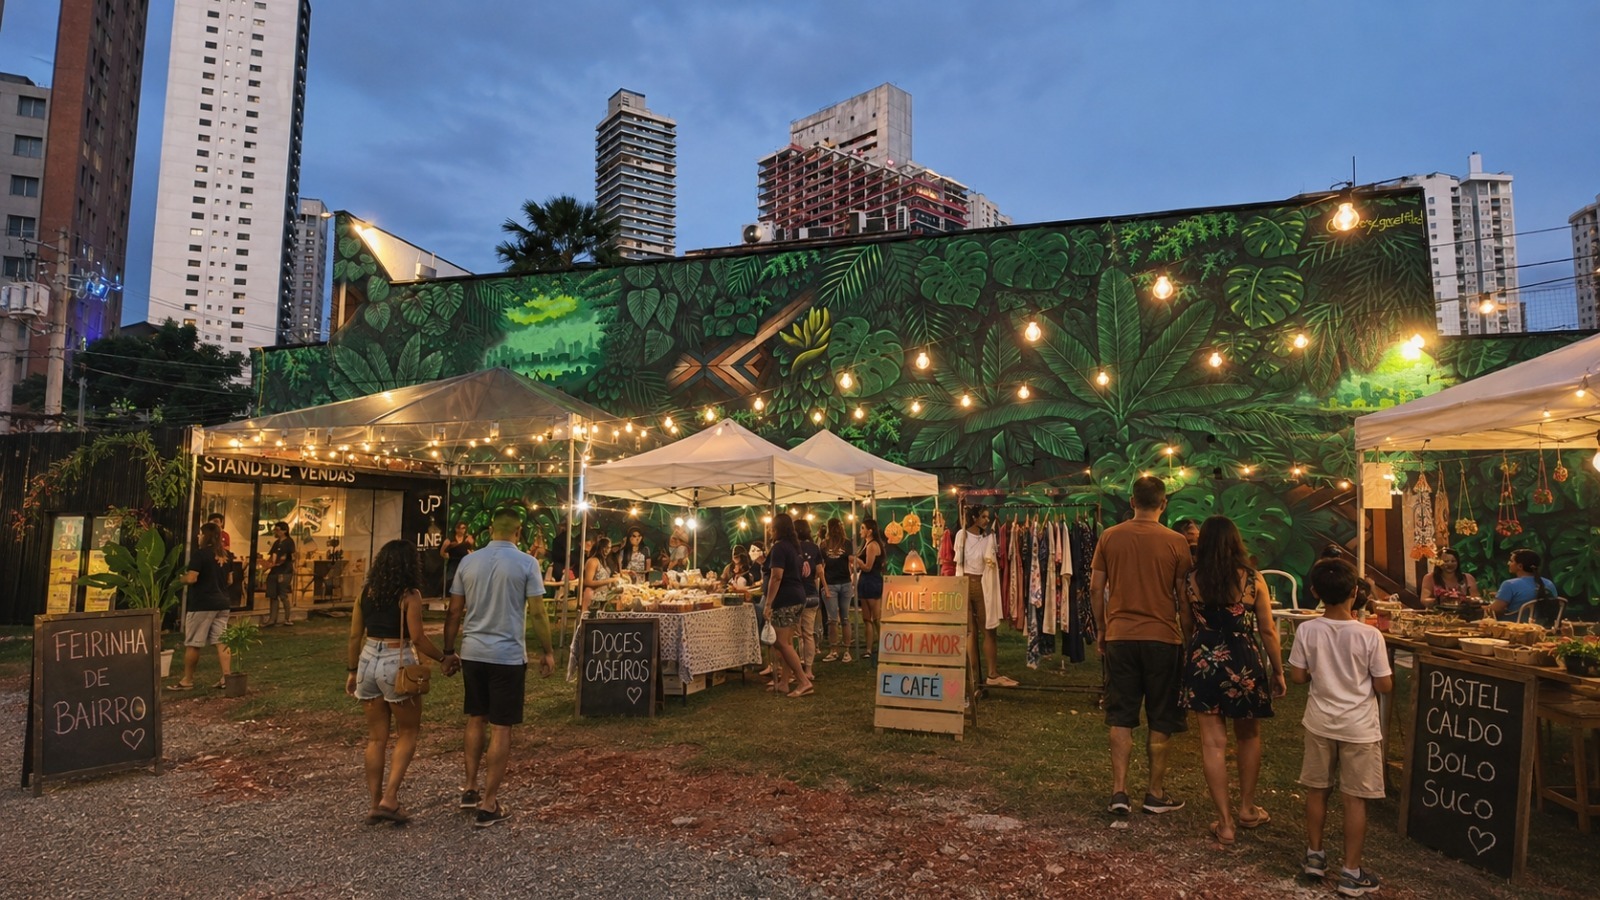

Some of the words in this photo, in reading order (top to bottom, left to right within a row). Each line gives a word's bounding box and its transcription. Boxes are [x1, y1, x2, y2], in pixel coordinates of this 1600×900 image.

[203, 455, 262, 476] STAND
[271, 463, 292, 479] DE
[300, 466, 356, 483] VENDAS
[418, 494, 442, 515] UP
[930, 591, 963, 612] FEITO
[52, 628, 149, 662] FEIRINHA
[591, 629, 644, 655] DOCES
[883, 631, 914, 653] COM
[919, 632, 962, 656] AMOR
[83, 666, 110, 689] DE
[882, 674, 893, 694] E
[900, 672, 940, 698] CAFÉ
[1429, 670, 1509, 714] PASTEL
[53, 696, 147, 735] BAIRRO
[1426, 707, 1503, 747] CALDO
[1426, 741, 1496, 783] BOLO
[1422, 779, 1494, 820] SUCO
